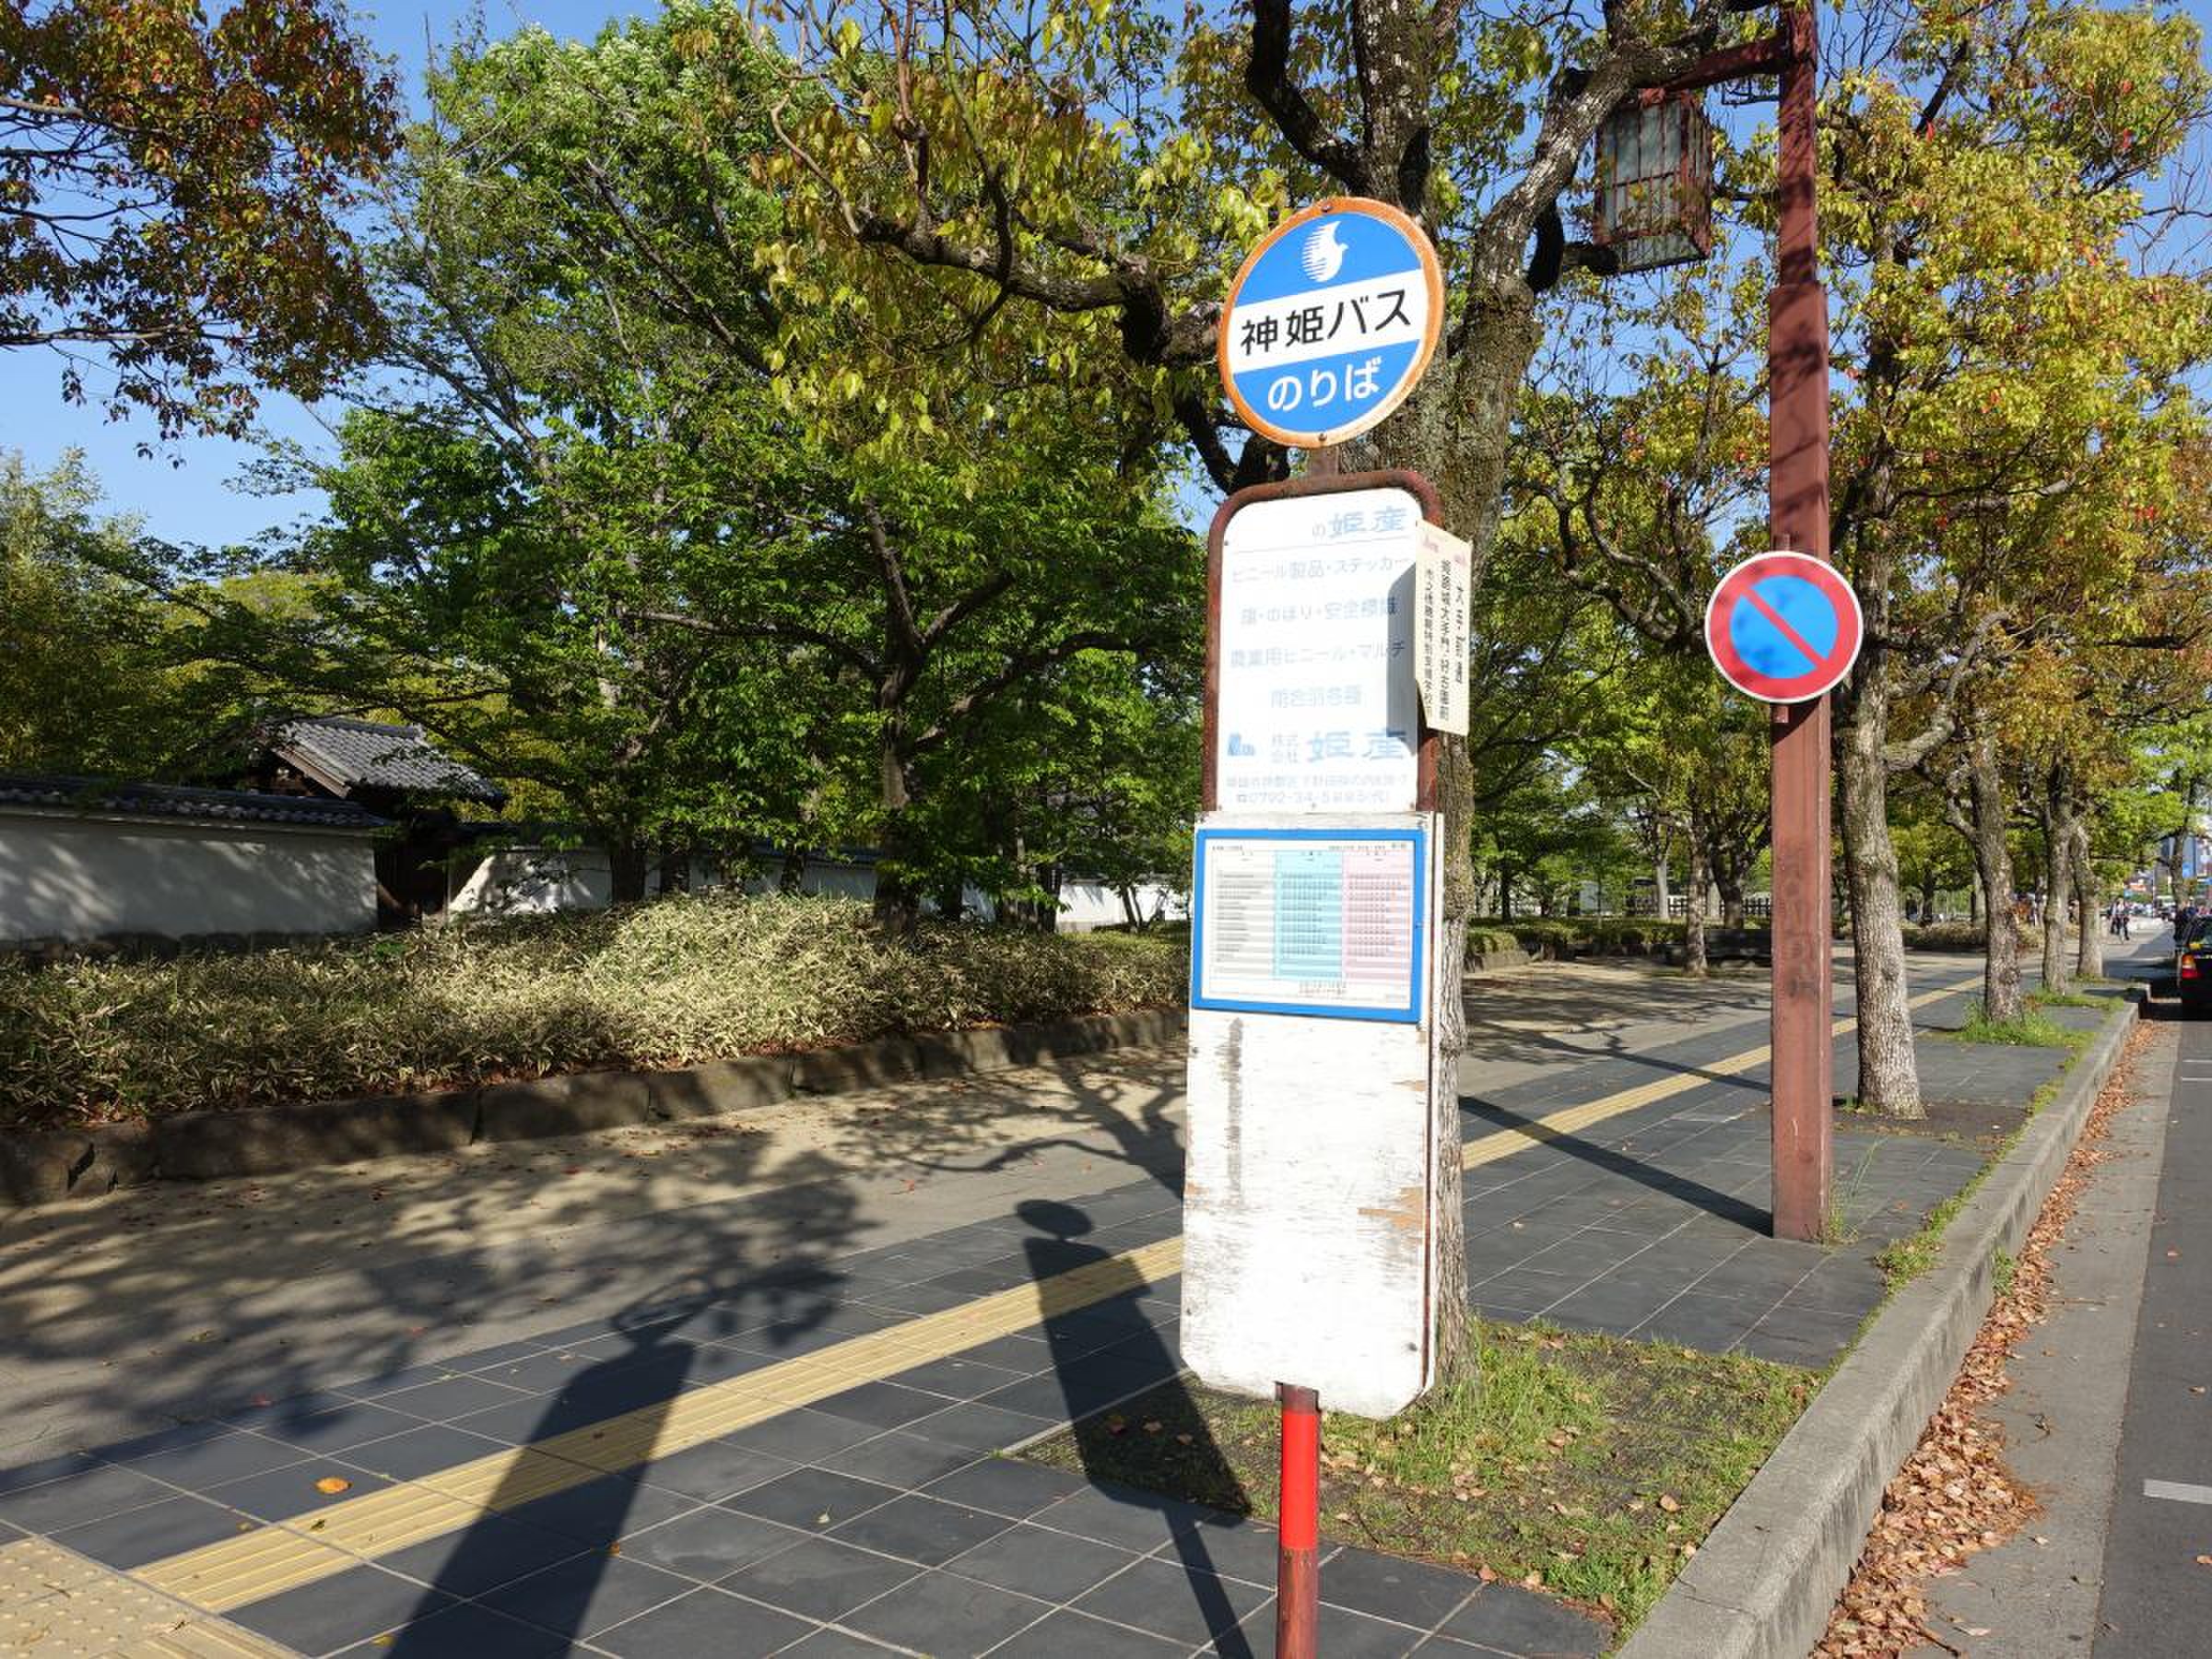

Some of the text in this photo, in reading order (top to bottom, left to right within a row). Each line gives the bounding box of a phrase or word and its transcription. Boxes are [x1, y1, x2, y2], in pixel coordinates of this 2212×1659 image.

[1240, 288, 1411, 357] 神姫バス
[1267, 356, 1382, 411] のりば
